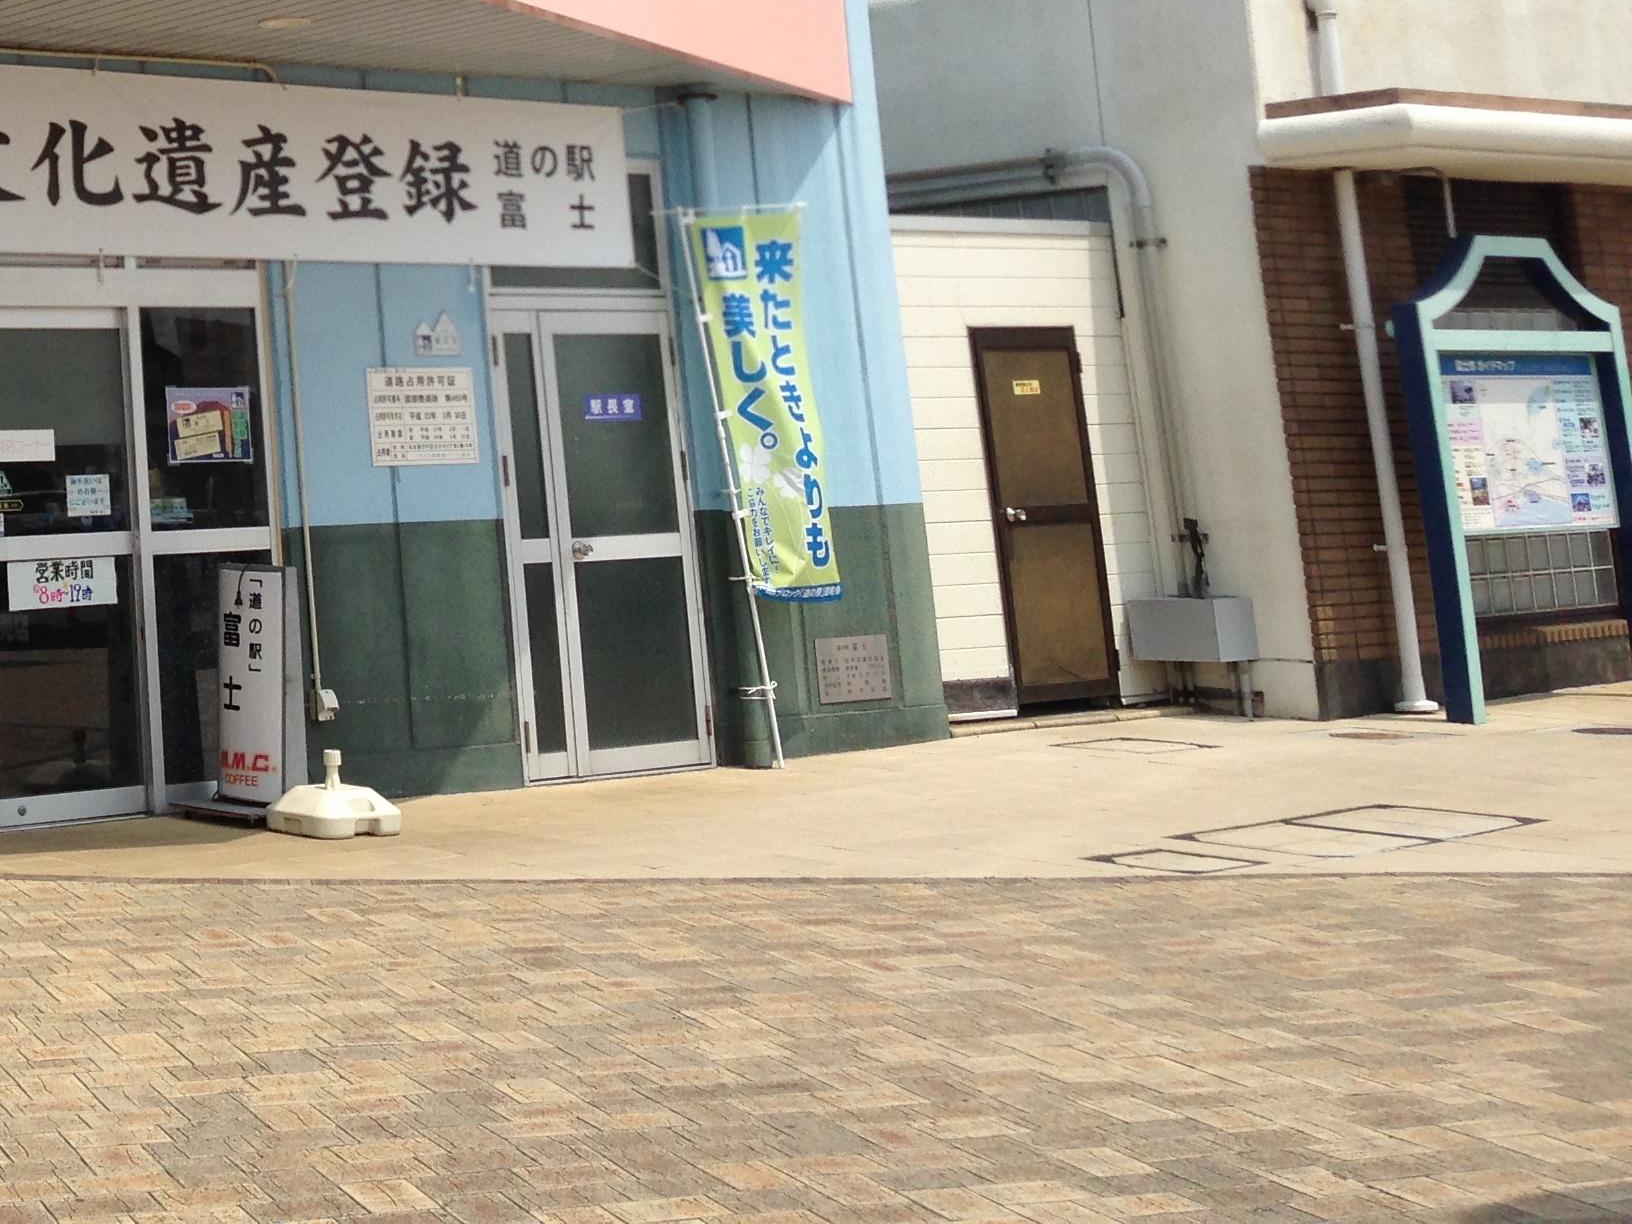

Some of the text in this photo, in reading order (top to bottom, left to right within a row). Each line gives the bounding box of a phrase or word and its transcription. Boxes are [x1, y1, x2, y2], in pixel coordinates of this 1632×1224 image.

[493, 140, 595, 181] 道の駅
[497, 190, 595, 229] 富士
[722, 292, 778, 450] 美しく。
[754, 239, 831, 567] 来たときよりも
[35, 560, 94, 584] 営業時間
[248, 578, 263, 673] 「道の駅」
[223, 611, 242, 711] 富士
[225, 773, 259, 787] COFFEE
